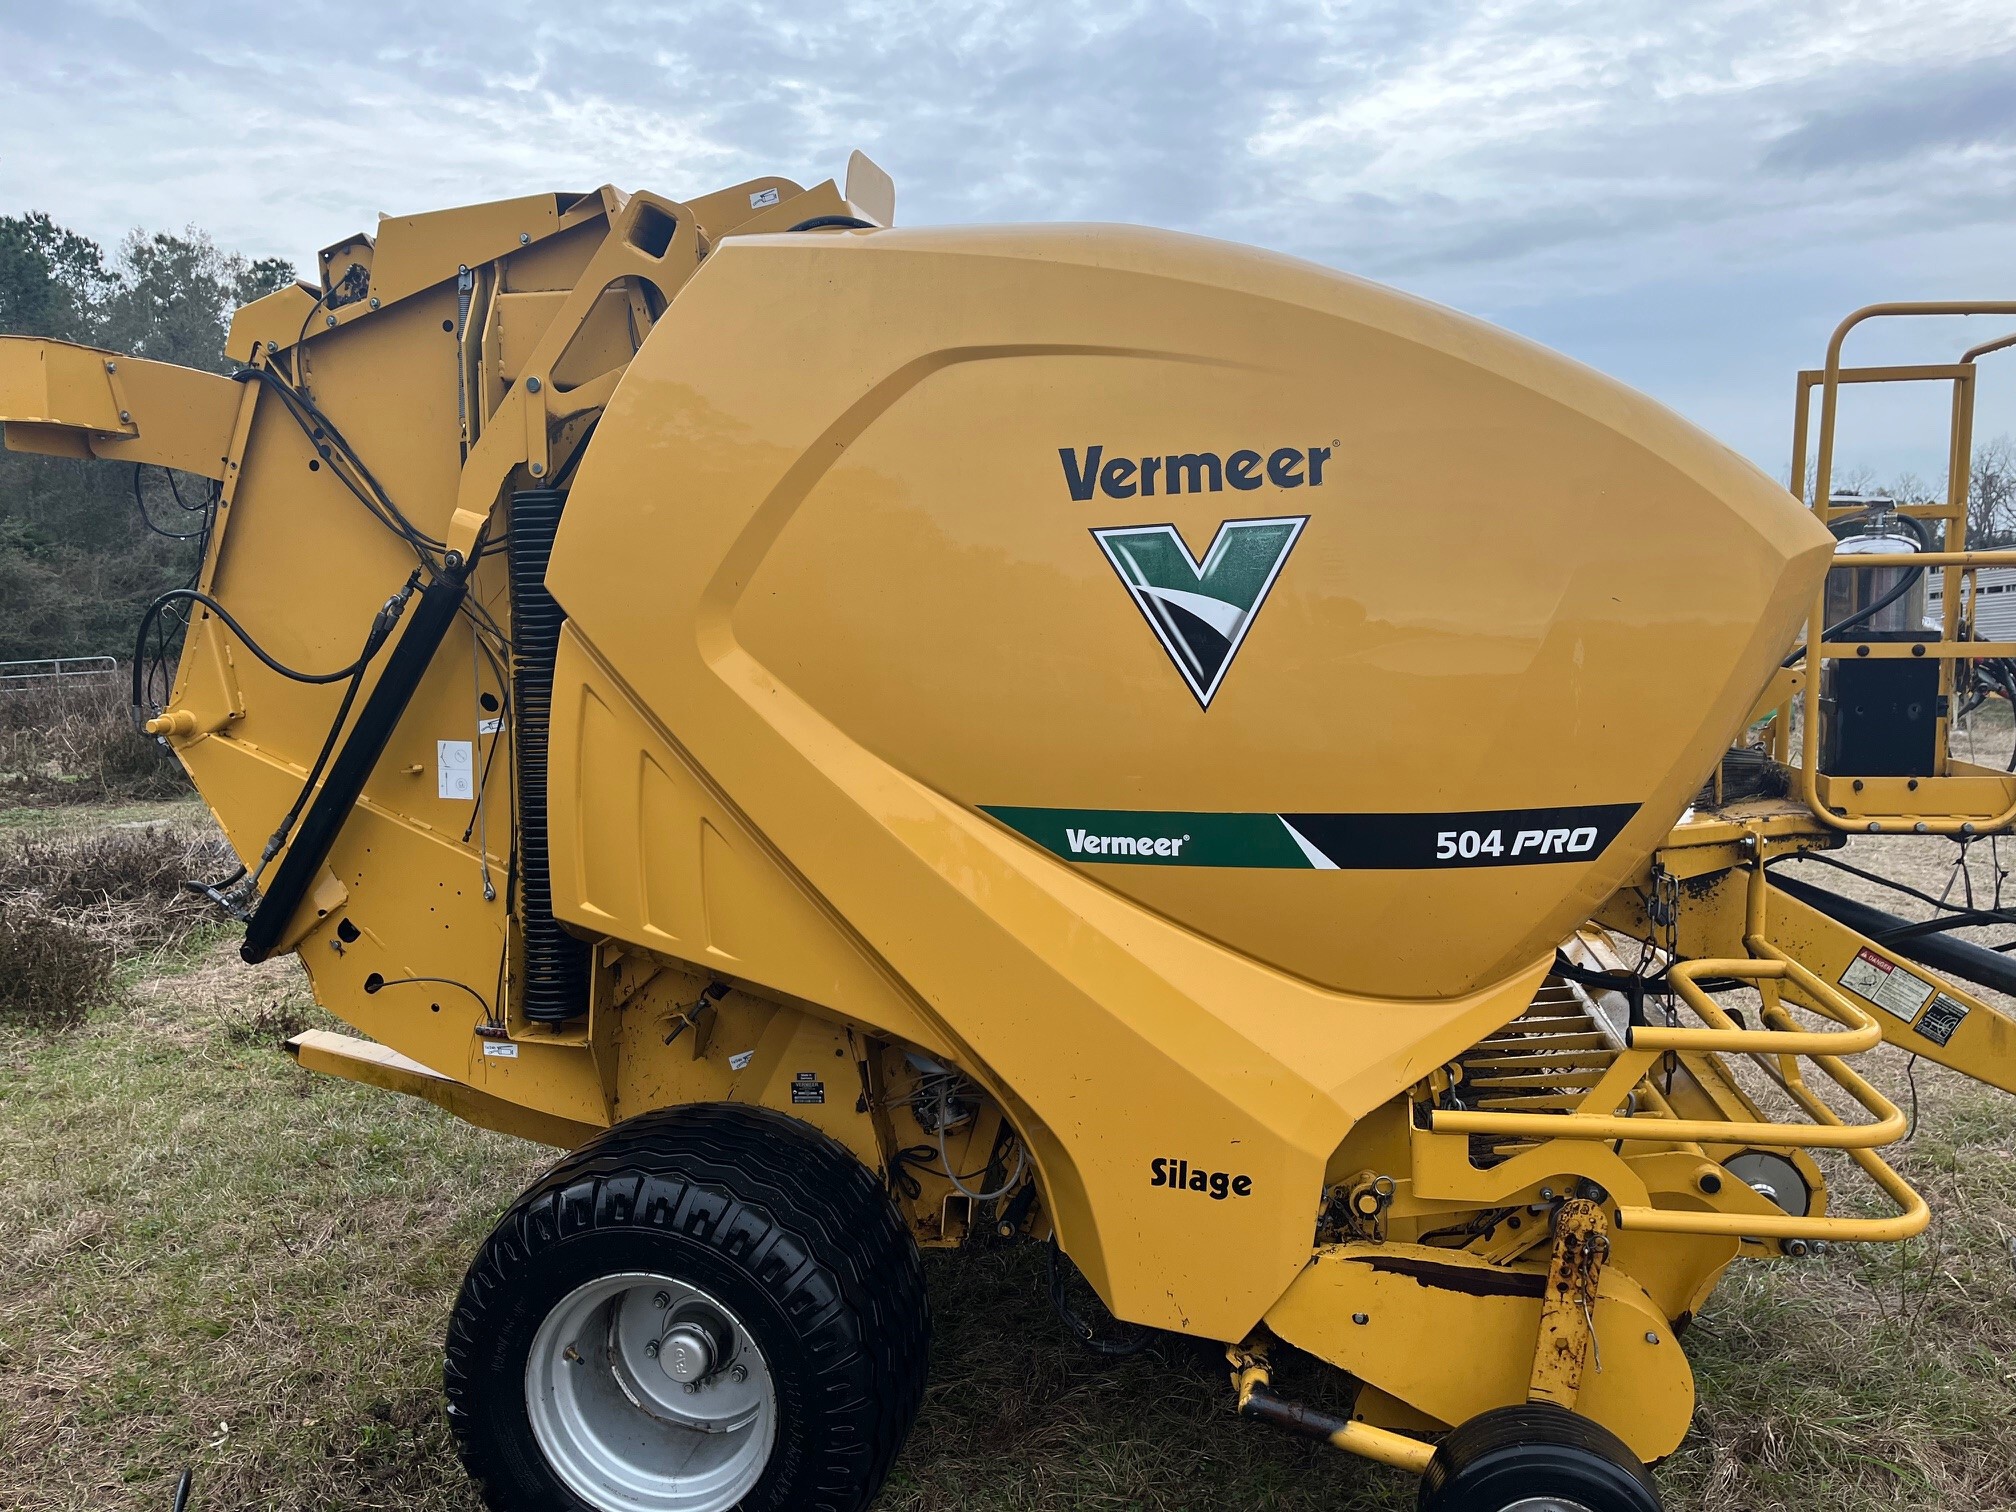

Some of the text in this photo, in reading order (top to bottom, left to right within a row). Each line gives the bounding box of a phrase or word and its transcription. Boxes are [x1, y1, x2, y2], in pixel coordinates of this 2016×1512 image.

[1436, 826, 1598, 860] 504 PRO
[1868, 954, 1892, 972] DANGER
[1150, 1157, 1253, 1201] Silage
